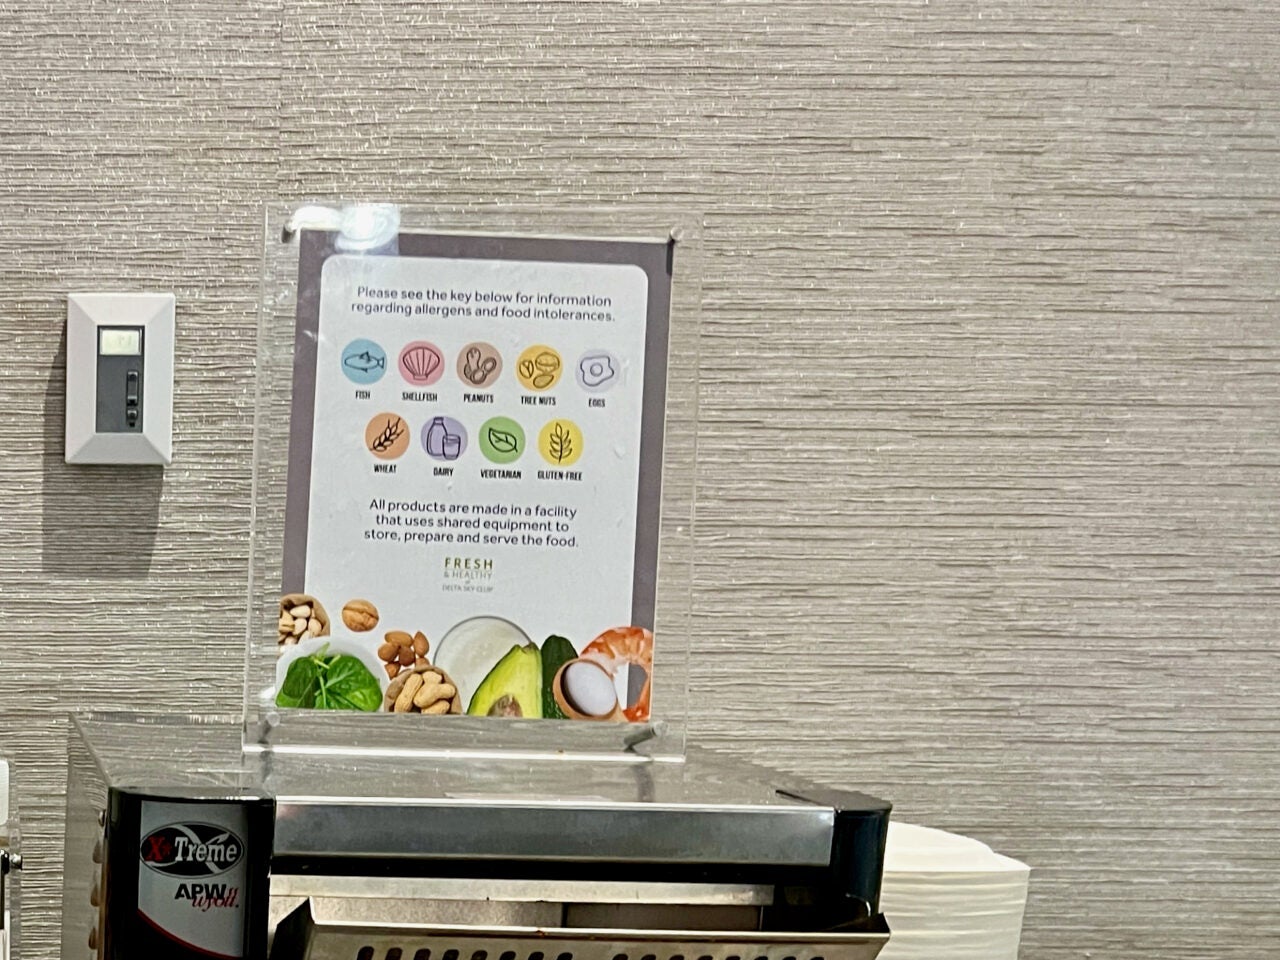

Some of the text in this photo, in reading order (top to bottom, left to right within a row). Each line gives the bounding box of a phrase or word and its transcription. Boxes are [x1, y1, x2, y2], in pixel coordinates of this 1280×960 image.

[357, 286, 612, 307] Please see the key below for information
[351, 302, 615, 322] regarding allergens and food intolerances.
[355, 391, 371, 400] FISH
[402, 392, 438, 401] SHELLFISH
[463, 394, 494, 403] PEANUTS
[521, 396, 556, 406] TREE NUTS
[588, 398, 605, 407] EGGS
[374, 464, 397, 474] WHEAT
[433, 467, 454, 477] DAIRY
[480, 469, 522, 479] VEGETARIAN
[369, 499, 577, 520] All products are made in a facility
[376, 514, 569, 532] that uses shared equipment to
[364, 529, 579, 548] store, prepare and serve the food.
[444, 557, 493, 570] FRESH
[452, 570, 492, 580] HEALTHY
[174, 883, 227, 900] APW
